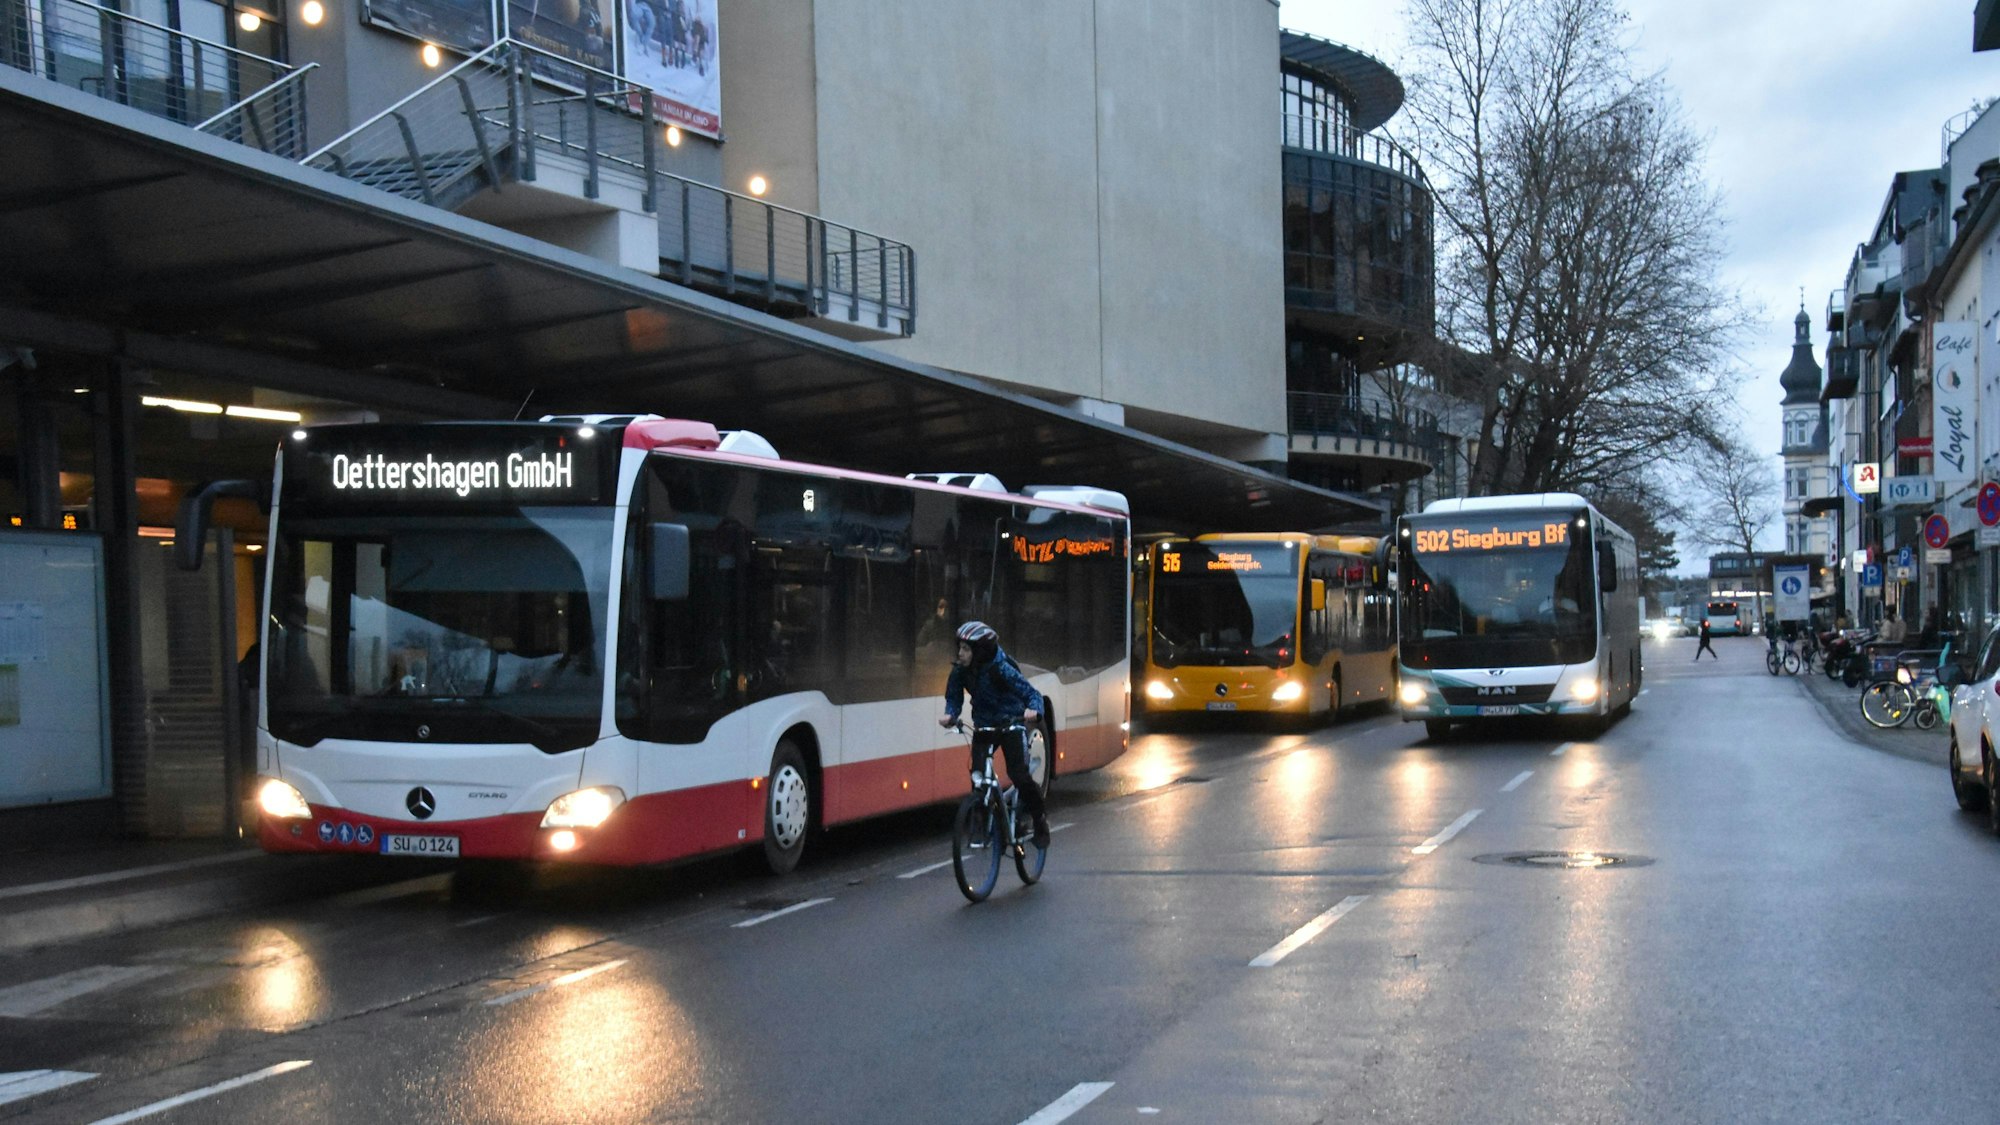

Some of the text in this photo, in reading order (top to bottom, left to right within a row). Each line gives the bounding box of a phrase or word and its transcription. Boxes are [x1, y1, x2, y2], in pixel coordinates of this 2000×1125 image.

[1936, 336, 1972, 354] Café
[1940, 405, 1970, 473] Loyal
[333, 452, 572, 497] Oettershagen GmbH
[1416, 523, 1567, 553] 502 Siegburg Bf
[1163, 552, 1181, 572] 515
[1867, 565, 1878, 583] P
[1477, 686, 1517, 696] MAN
